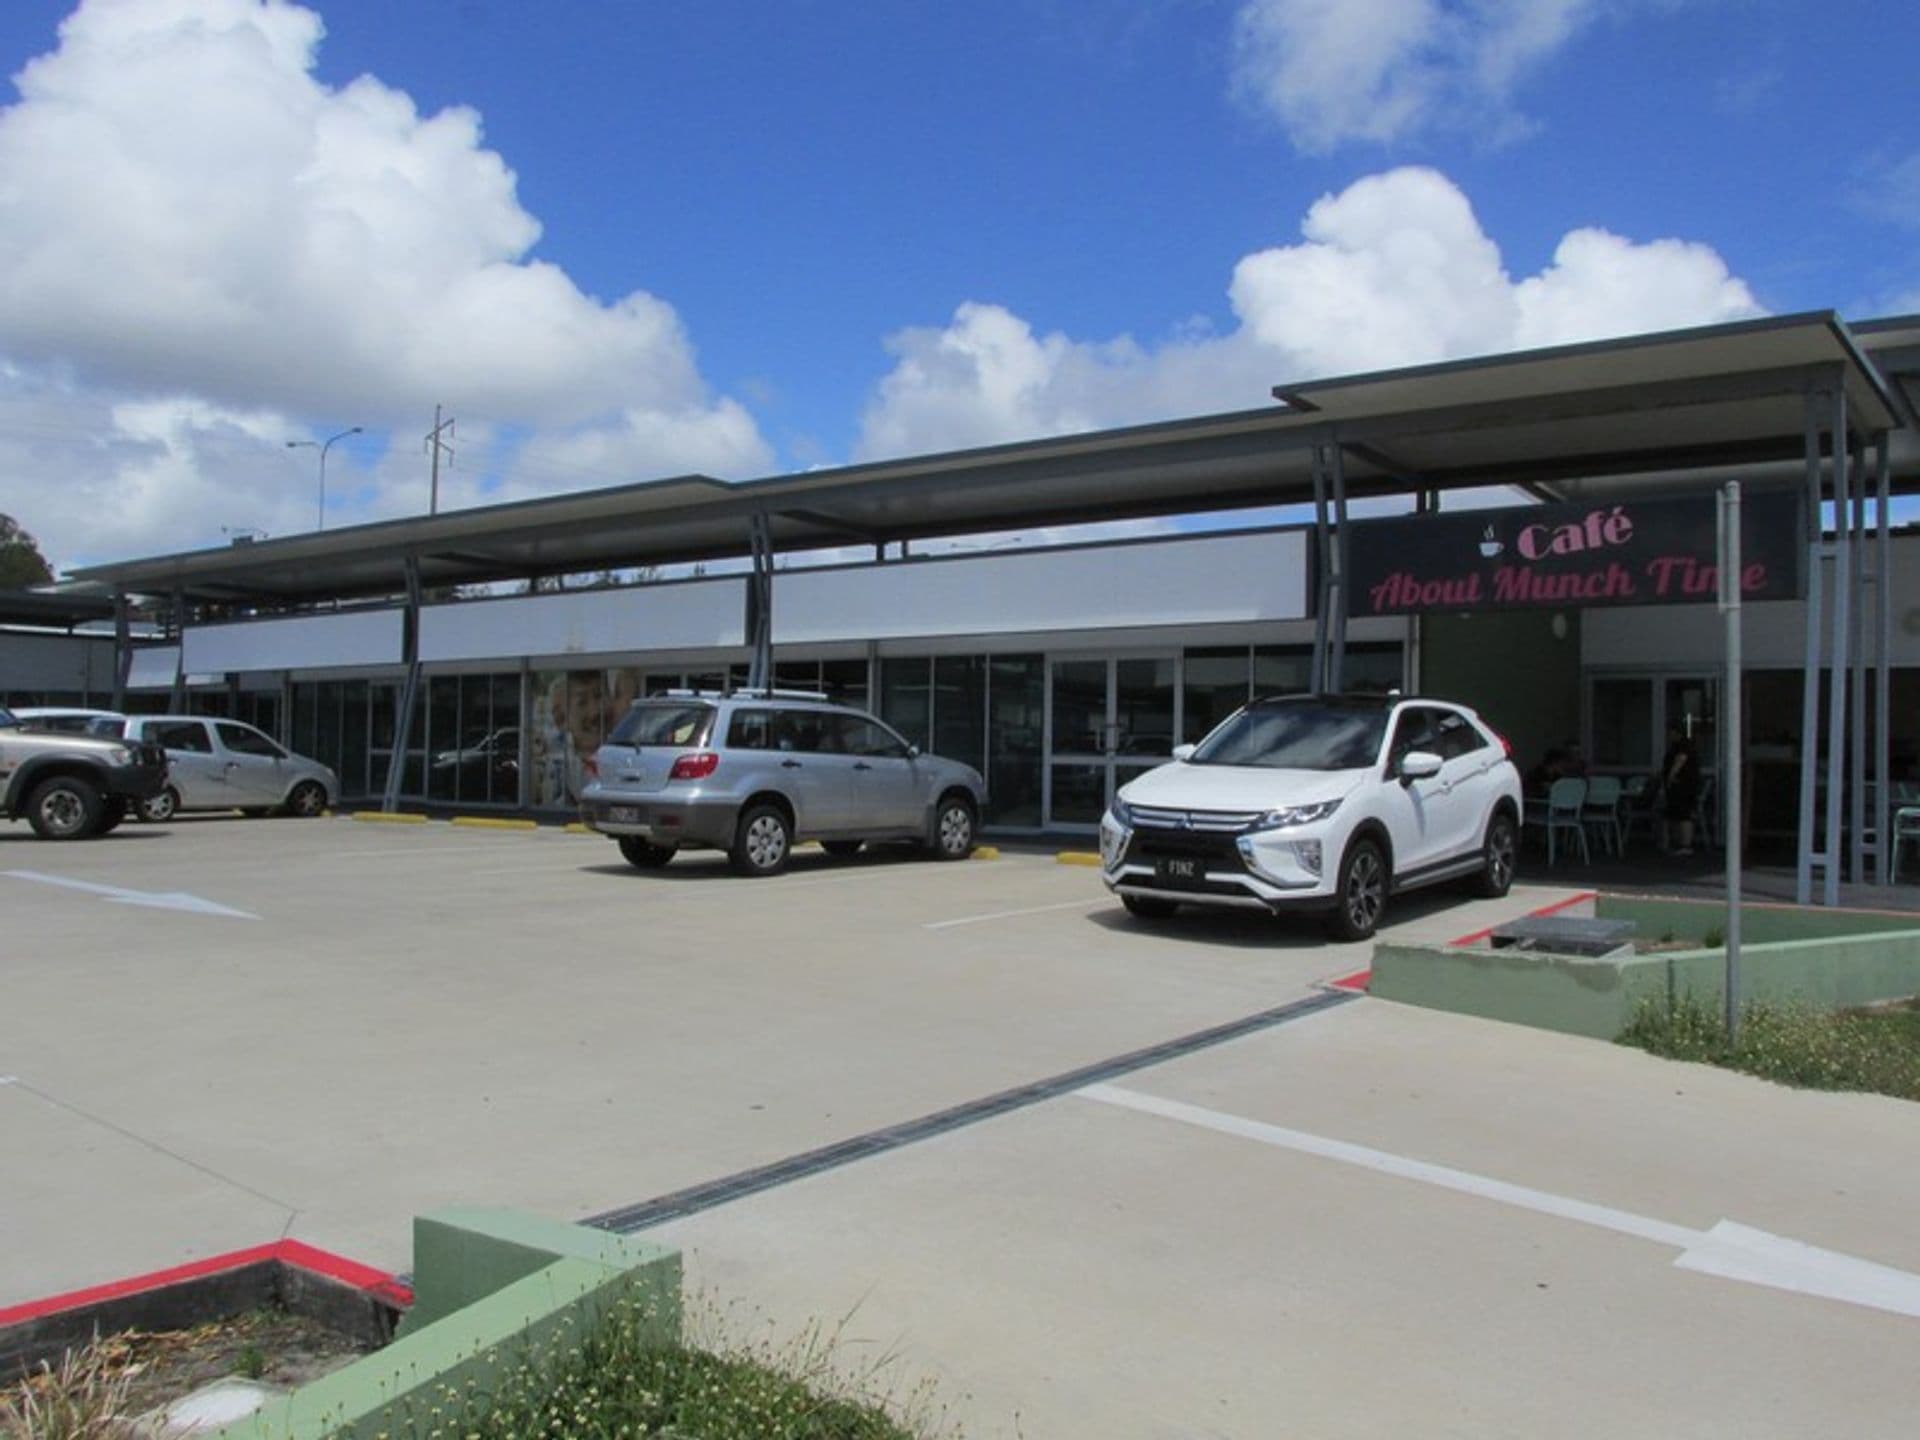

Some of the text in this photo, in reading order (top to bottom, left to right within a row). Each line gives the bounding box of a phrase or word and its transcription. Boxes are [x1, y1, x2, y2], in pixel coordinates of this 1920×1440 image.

[1516, 505, 1634, 560] Café
[1369, 570, 1482, 612] About
[1493, 561, 1637, 602] Munch
